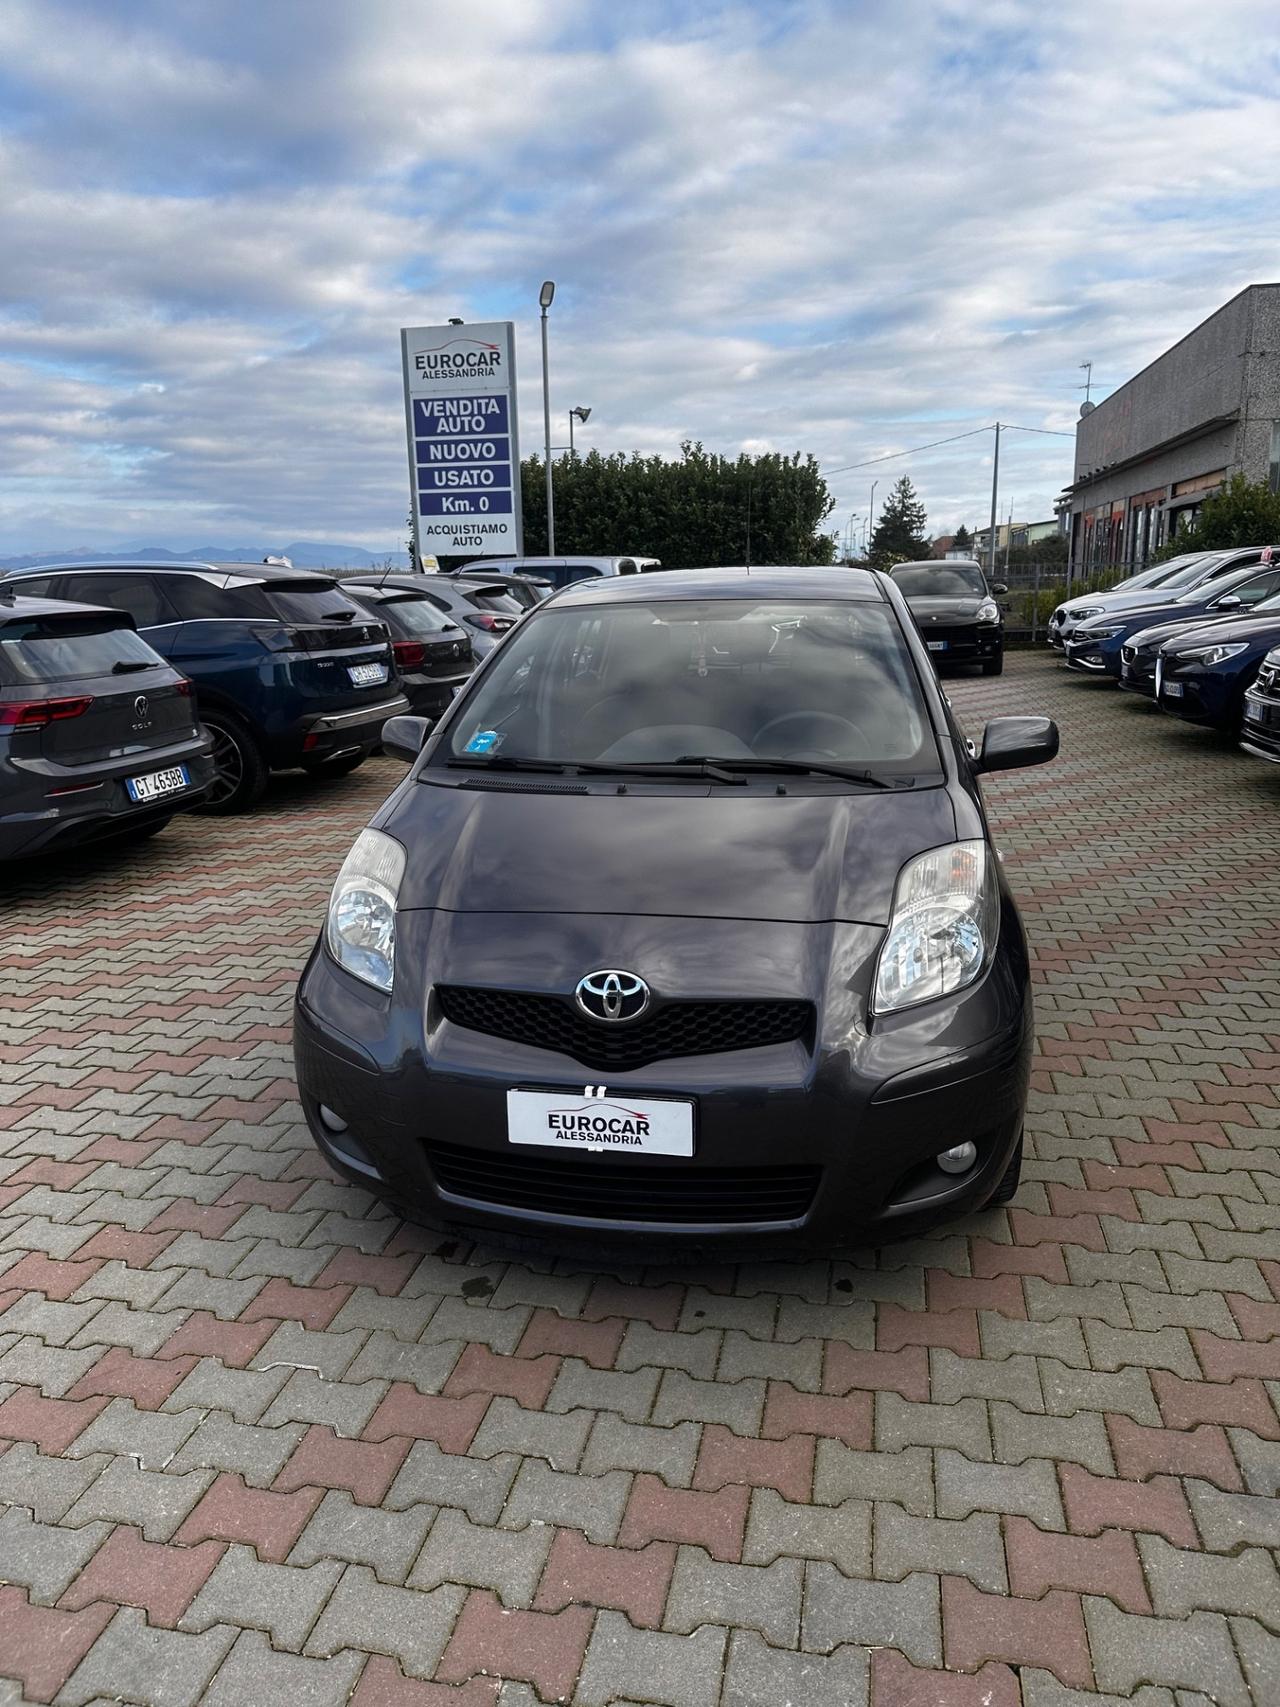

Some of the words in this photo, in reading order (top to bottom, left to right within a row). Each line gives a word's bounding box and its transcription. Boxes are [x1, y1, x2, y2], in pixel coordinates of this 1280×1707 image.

[415, 351, 501, 370] EUROCAR
[422, 368, 495, 379] ALESSANDRIA
[420, 398, 500, 417] VENDITA
[436, 416, 485, 433] AUTO
[430, 442, 496, 460] NUOVO
[434, 469, 494, 486] USATO
[442, 497, 474, 512] Km.
[479, 496, 489, 511] 0
[427, 523, 508, 536] ACQUISTIAMO
[452, 536, 482, 546] AUTO
[154, 768, 184, 791] 463BB
[548, 1114, 650, 1136] EUROCAR
[556, 1130, 643, 1146] ALESSANDRIA
